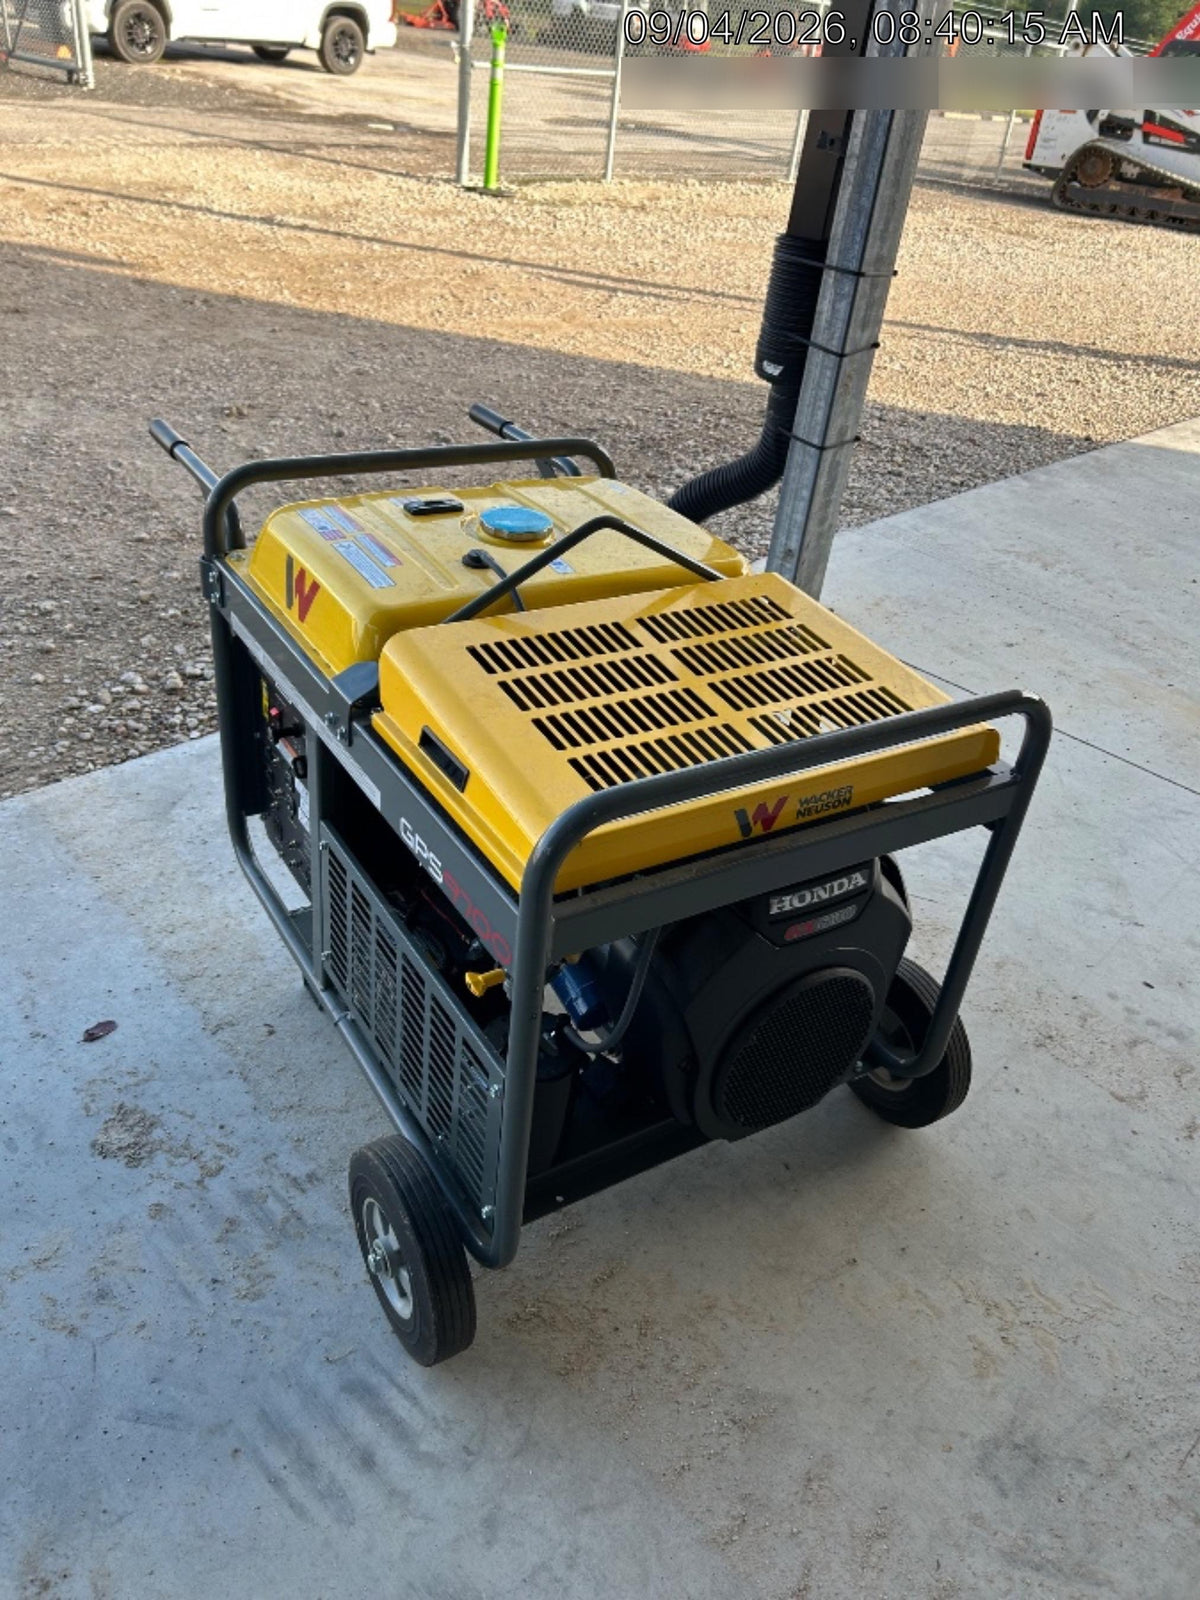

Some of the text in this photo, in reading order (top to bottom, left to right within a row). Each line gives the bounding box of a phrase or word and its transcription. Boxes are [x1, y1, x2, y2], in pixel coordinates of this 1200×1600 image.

[796, 795, 853, 820] NEUSON
[799, 785, 854, 808] WACKER
[769, 871, 867, 915] HONDA
